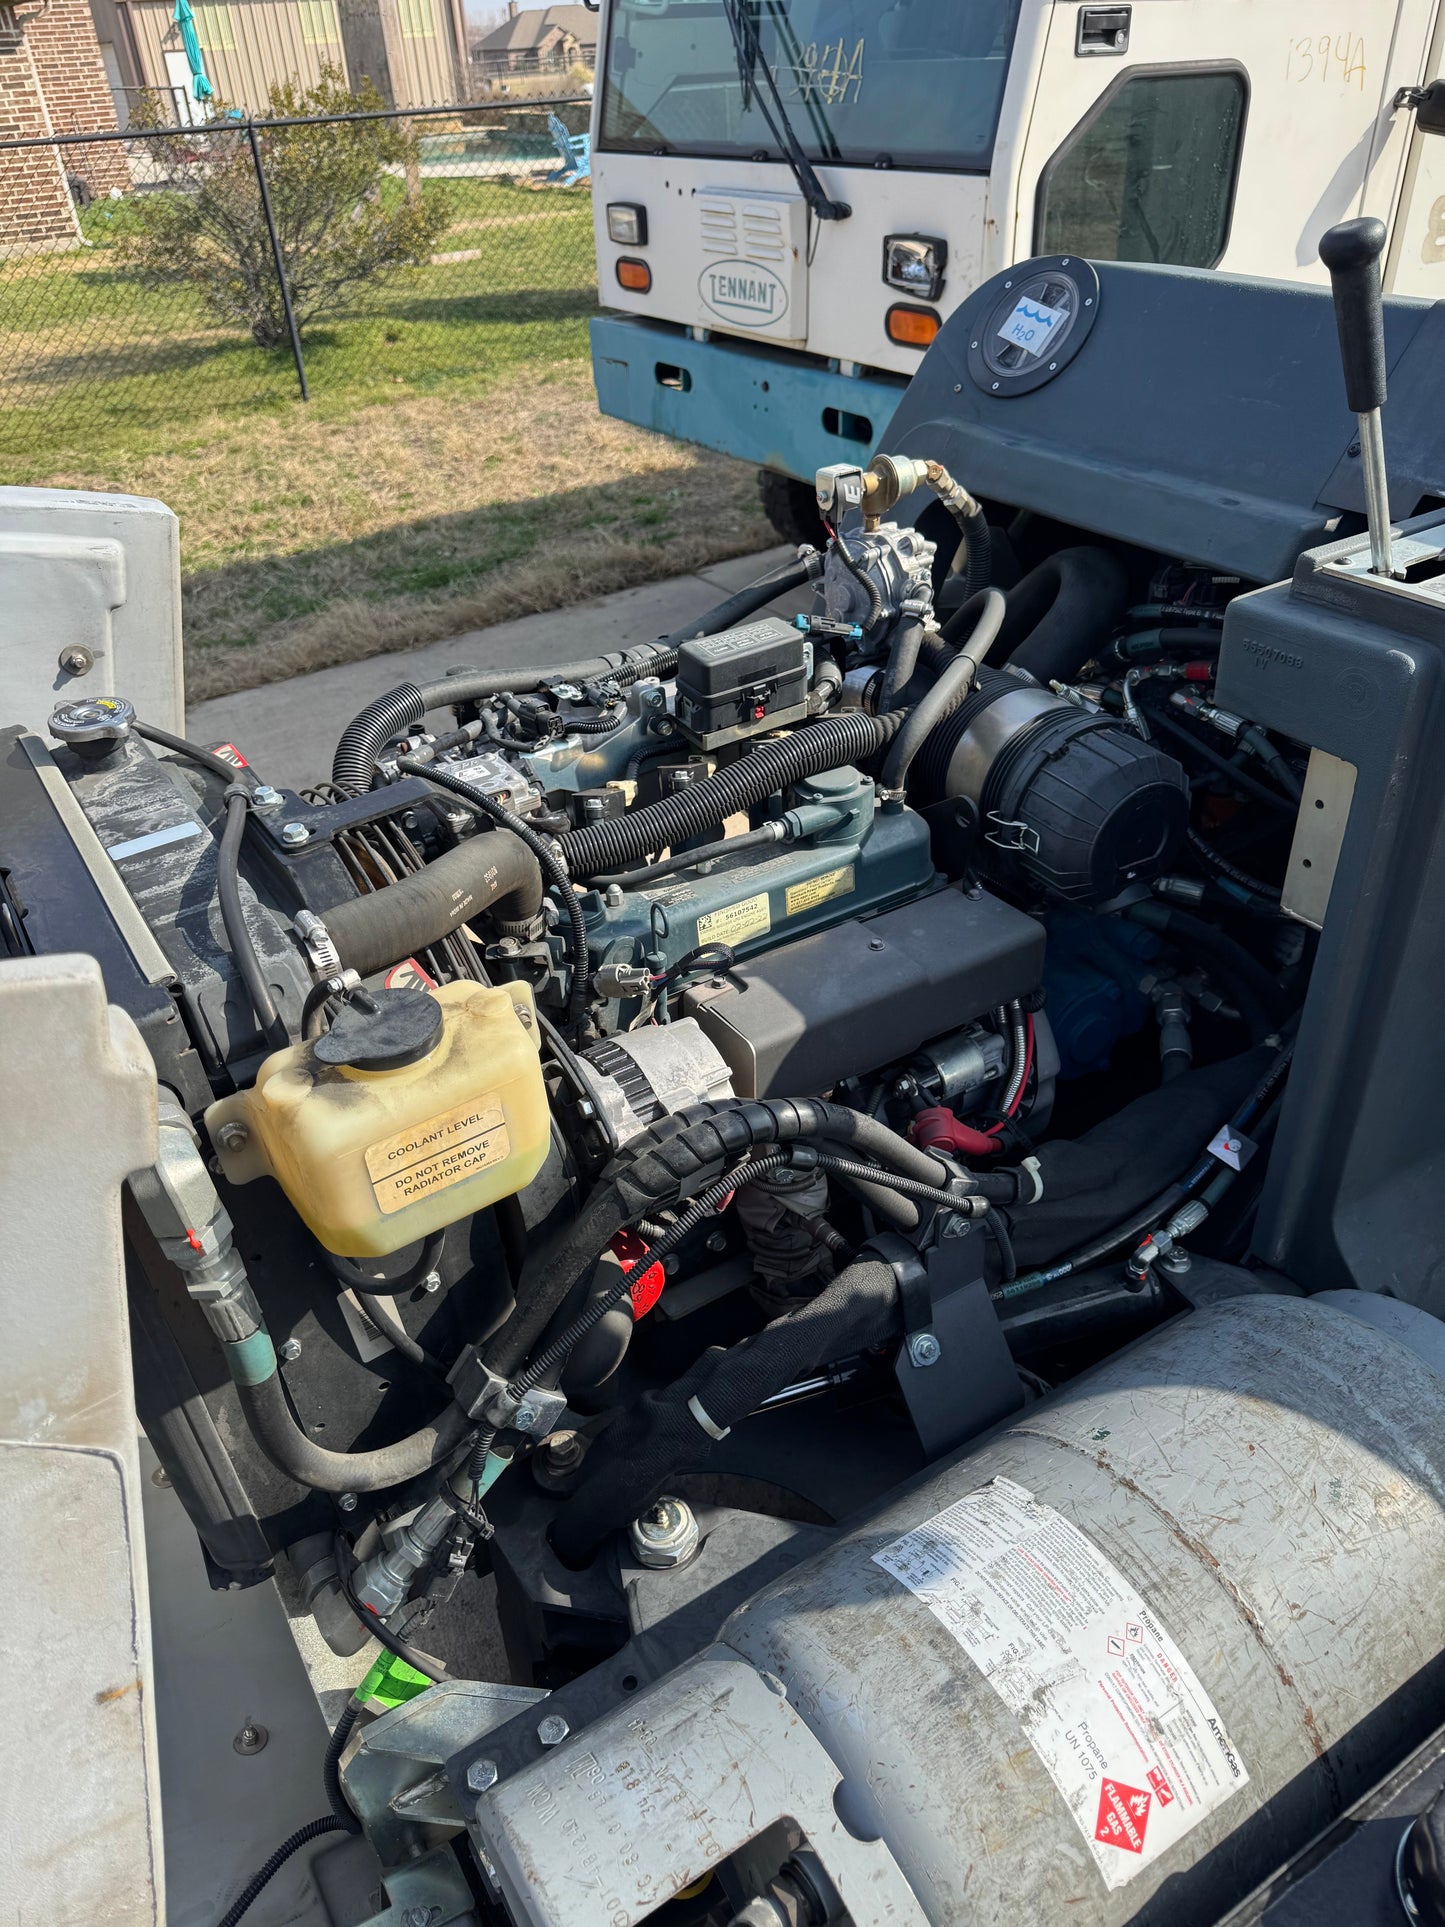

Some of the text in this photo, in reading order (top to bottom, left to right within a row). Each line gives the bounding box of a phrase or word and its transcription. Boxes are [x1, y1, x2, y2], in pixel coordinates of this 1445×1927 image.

[1286, 32, 1366, 91] 1394A
[709, 274, 776, 314] TENNANT
[1011, 323, 1035, 341] H2O
[725, 903, 759, 921] 56107542
[387, 1113, 484, 1160] COOLANT LEVEL
[395, 1175, 413, 1189] DO
[415, 1163, 439, 1180] NOT
[442, 1140, 490, 1168] REMOVE
[403, 1152, 487, 1196] RADIATOR CAP
[950, 1577, 960, 1587] FIG.
[1034, 1637, 1045, 1650] LABEL
[1139, 1610, 1163, 1642] Propane
[1008, 1642, 1019, 1656] FIG.
[1157, 1653, 1178, 1682] DANGER
[1098, 1680, 1112, 1699] Personal
[1110, 1699, 1125, 1722] Protection
[1065, 1730, 1080, 1750] UN
[1078, 1751, 1098, 1780] 1075
[1077, 1721, 1108, 1769] Propane
[1100, 1826, 1109, 1837] 2
[1105, 1783, 1141, 1848] FLAMMABLE
[1107, 1812, 1122, 1835] GAS
